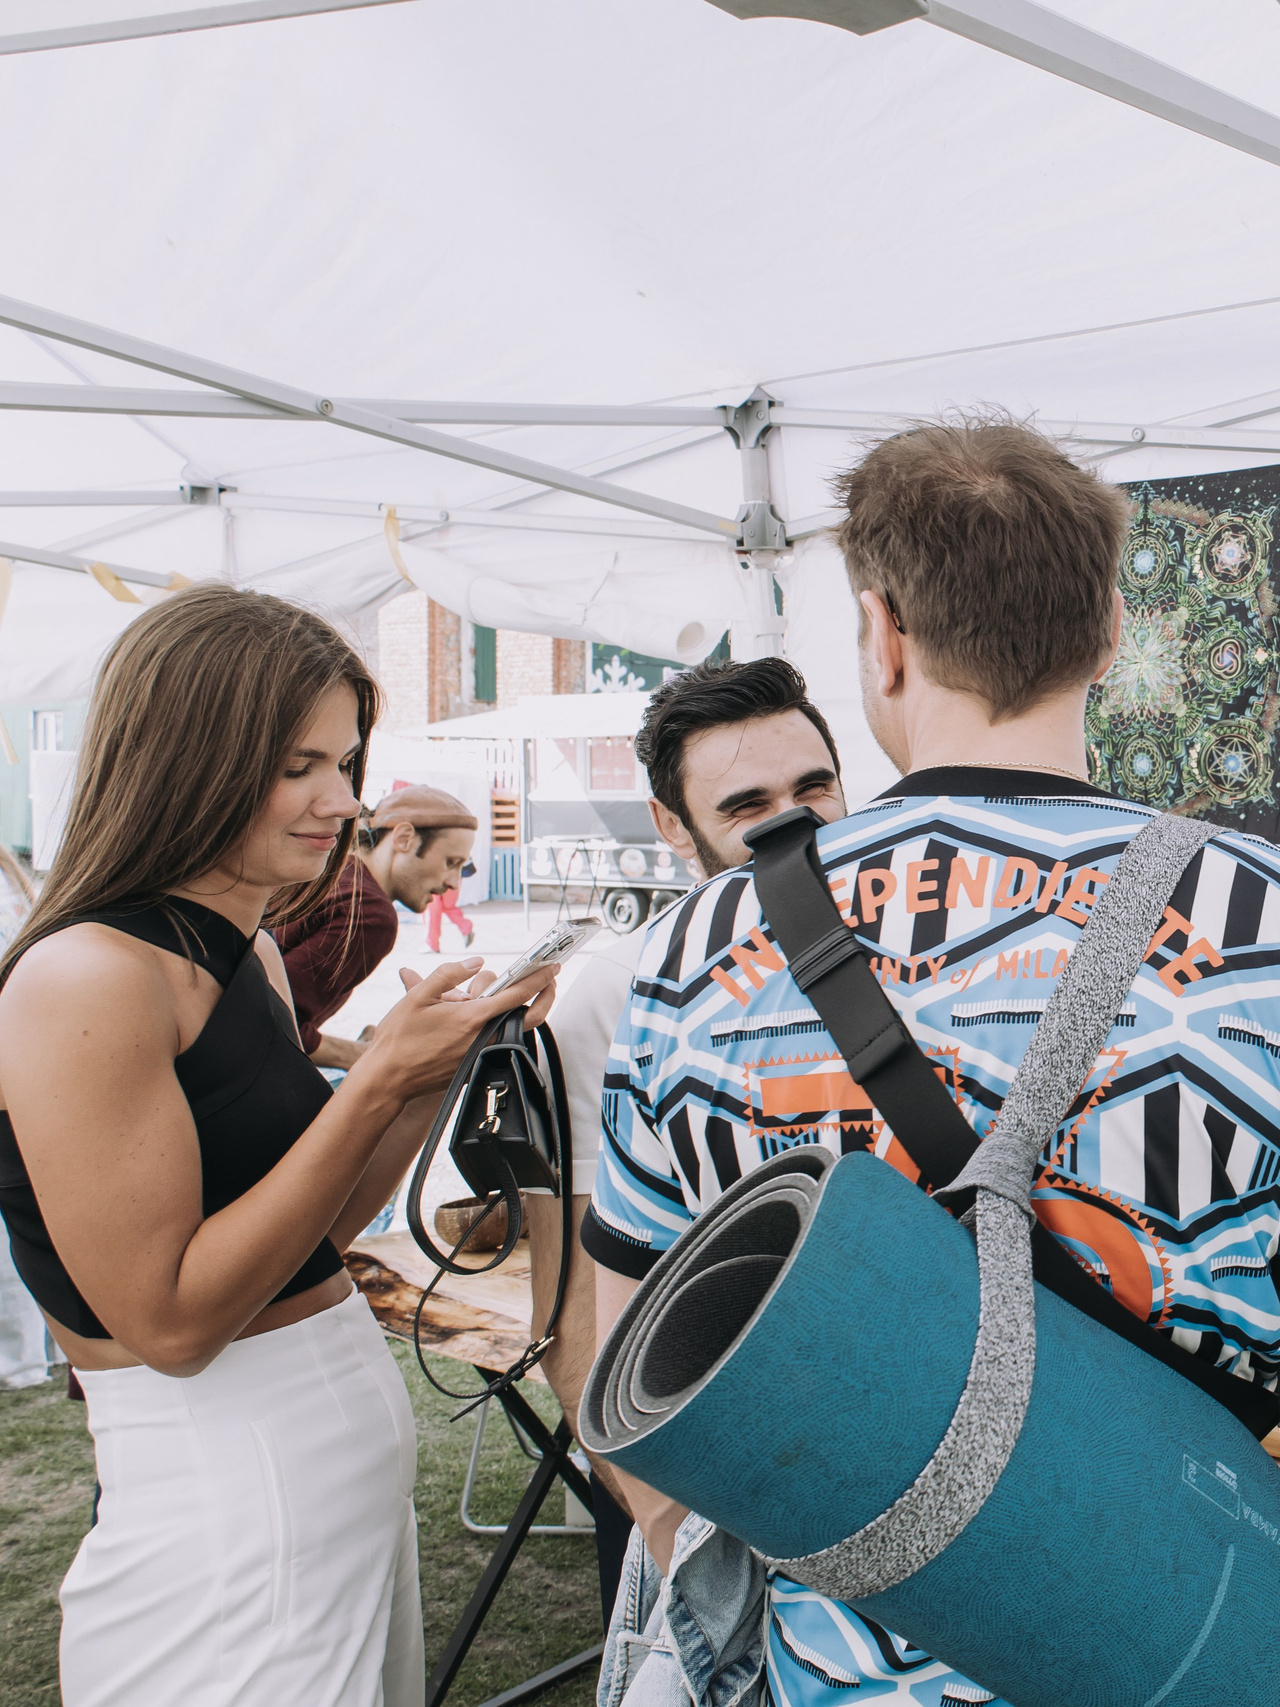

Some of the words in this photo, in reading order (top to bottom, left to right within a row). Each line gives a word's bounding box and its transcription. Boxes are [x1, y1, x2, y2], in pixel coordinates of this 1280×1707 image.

[709, 855, 1225, 1008] INEPENDIETE
[950, 955, 988, 993] of
[996, 948, 1069, 981] MILA
